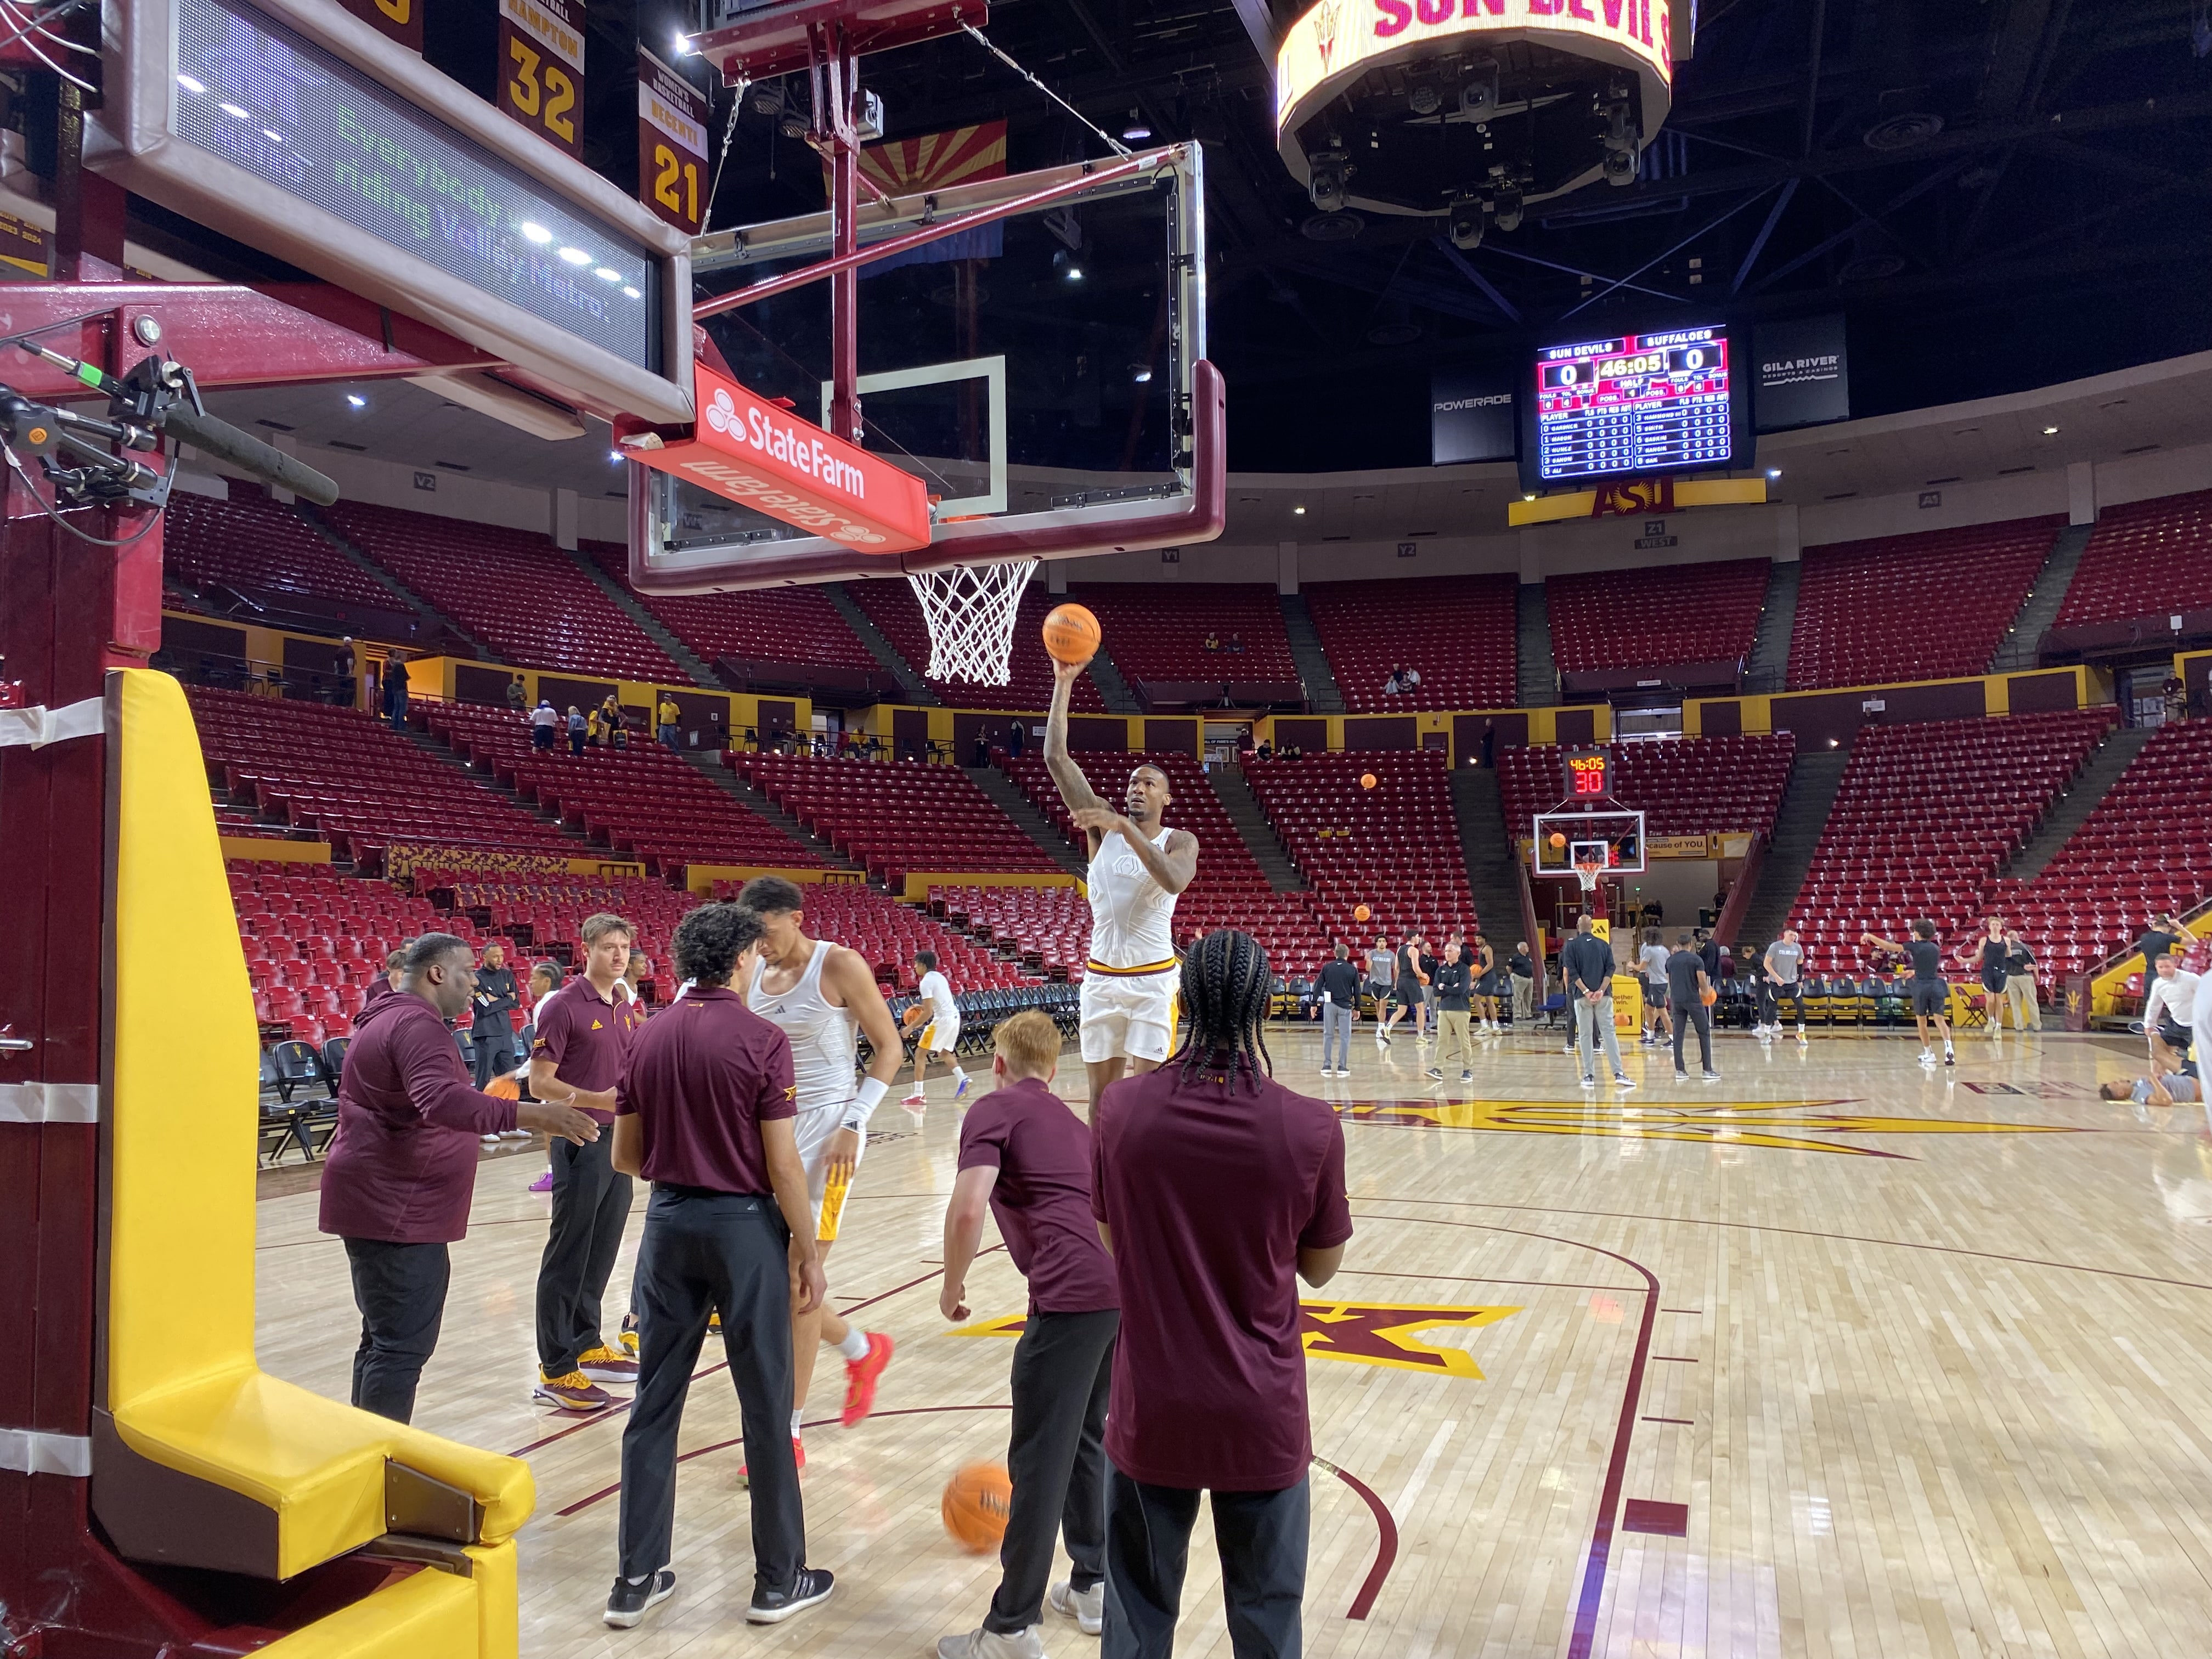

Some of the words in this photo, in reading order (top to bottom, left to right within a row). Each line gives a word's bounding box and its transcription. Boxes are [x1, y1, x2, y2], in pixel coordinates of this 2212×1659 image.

[509, 0, 578, 58] HAMPTON
[510, 35, 574, 144] 32
[657, 69, 690, 103] WOMEN'S
[653, 77, 695, 118] BASKETBALL
[651, 99, 698, 147] DECENTI
[337, 103, 503, 227] Everybody
[655, 144, 697, 224] 21
[334, 158, 431, 240] riding
[437, 205, 525, 285] Valley
[22, 231, 42, 245] 2024
[1647, 330, 1712, 347] BUFFALOES
[1550, 349, 1572, 359] SUN
[1574, 343, 1612, 357] DEVILS
[1686, 349, 1703, 370] 0
[1600, 356, 1661, 377] 46:05
[1763, 360, 1794, 373] GILA
[1797, 356, 1837, 369] RIVER
[1560, 365, 1577, 385] 0
[1620, 377, 1644, 388] HALF
[1434, 393, 1511, 413] POWERADE
[1635, 401, 1662, 410] PLAYER
[1542, 413, 1568, 422] PLAYER
[417, 475, 434, 488] V2
[1592, 476, 1674, 518] ASU
[1647, 523, 1664, 534] Z1
[1398, 544, 1415, 555] Y2
[1640, 538, 1672, 548] WEST
[1165, 550, 1179, 561] Y1
[690, 732, 697, 744] W
[1570, 757, 1605, 770] 46:05
[1576, 771, 1601, 793] 30
